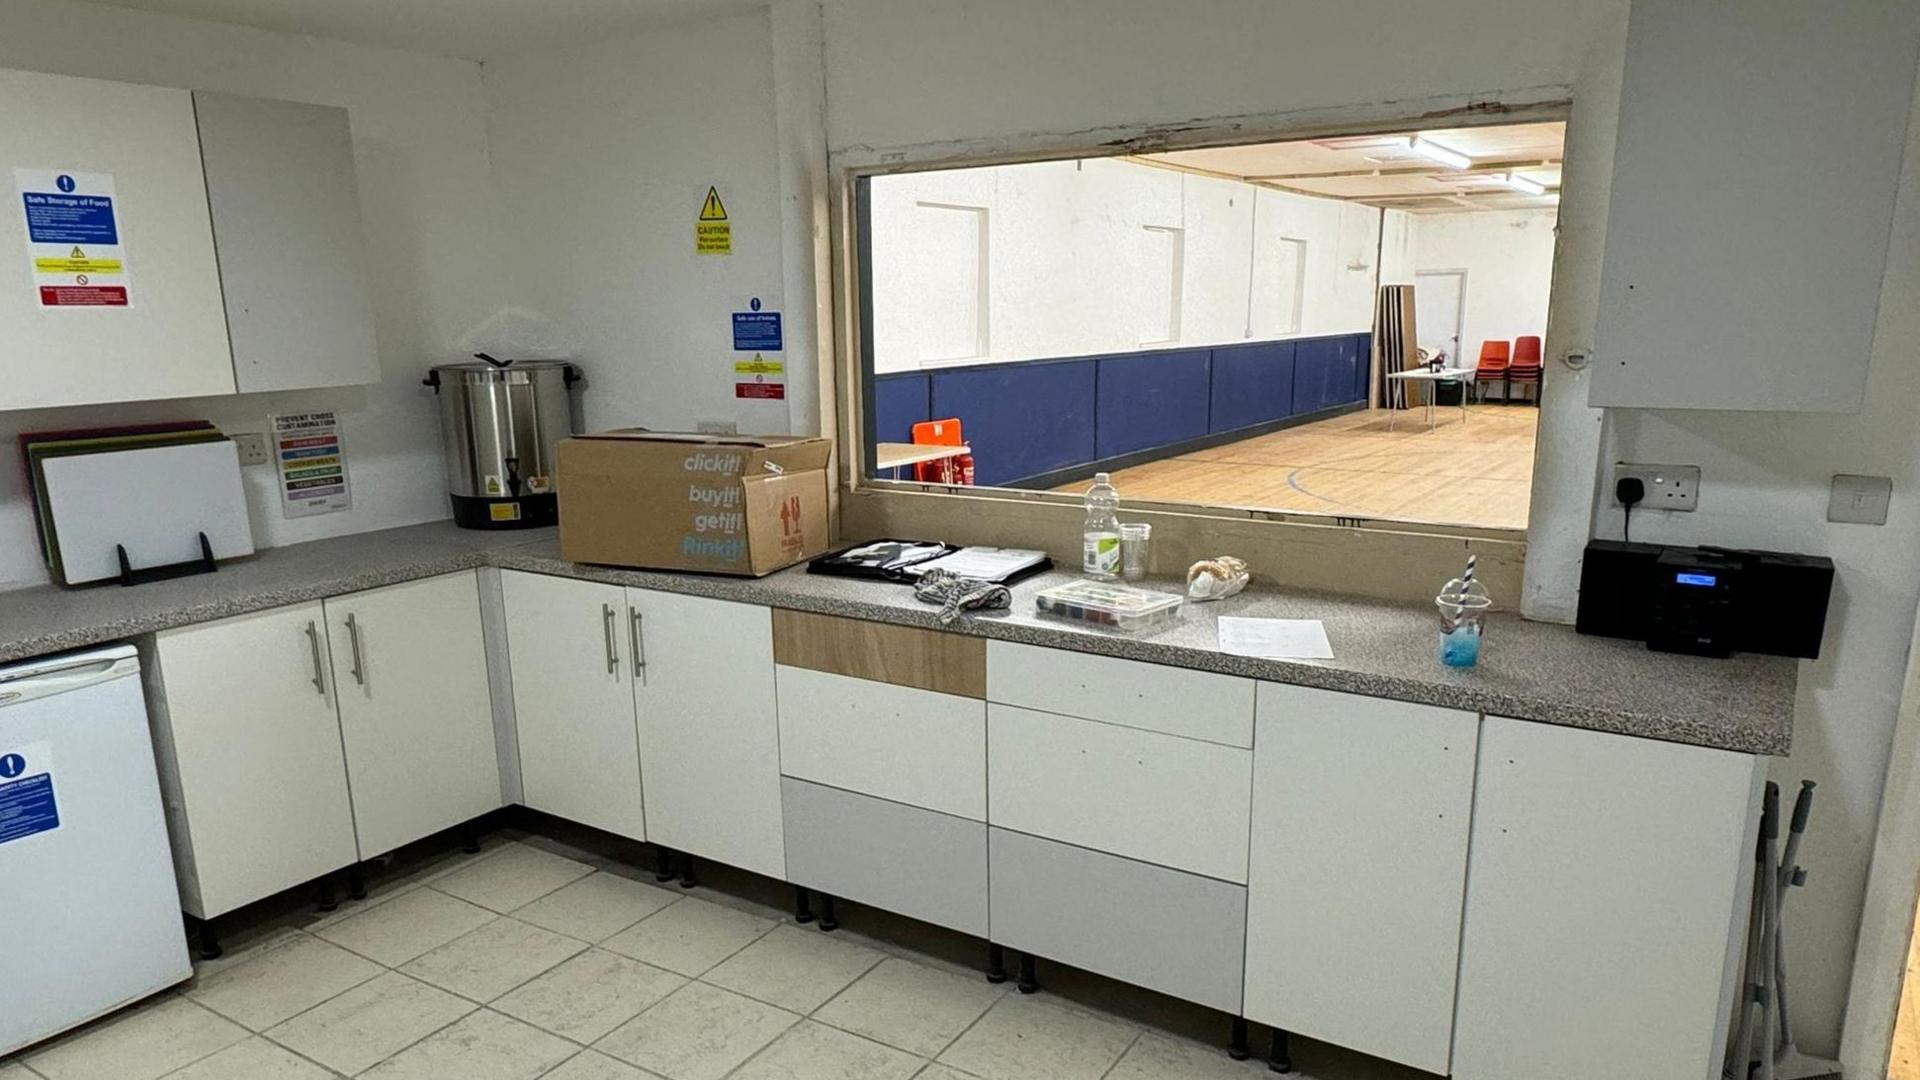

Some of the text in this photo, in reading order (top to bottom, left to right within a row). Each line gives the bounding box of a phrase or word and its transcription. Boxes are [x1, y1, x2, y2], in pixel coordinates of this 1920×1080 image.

[26, 195, 109, 208] Safe Storage of Food
[697, 225, 730, 235] CAUTION
[275, 412, 335, 423] PREVENT CROSS
[276, 419, 337, 431] CONTAMINATION
[683, 452, 742, 476] clickit!
[688, 484, 741, 508] buyit!
[694, 511, 743, 535] getit!
